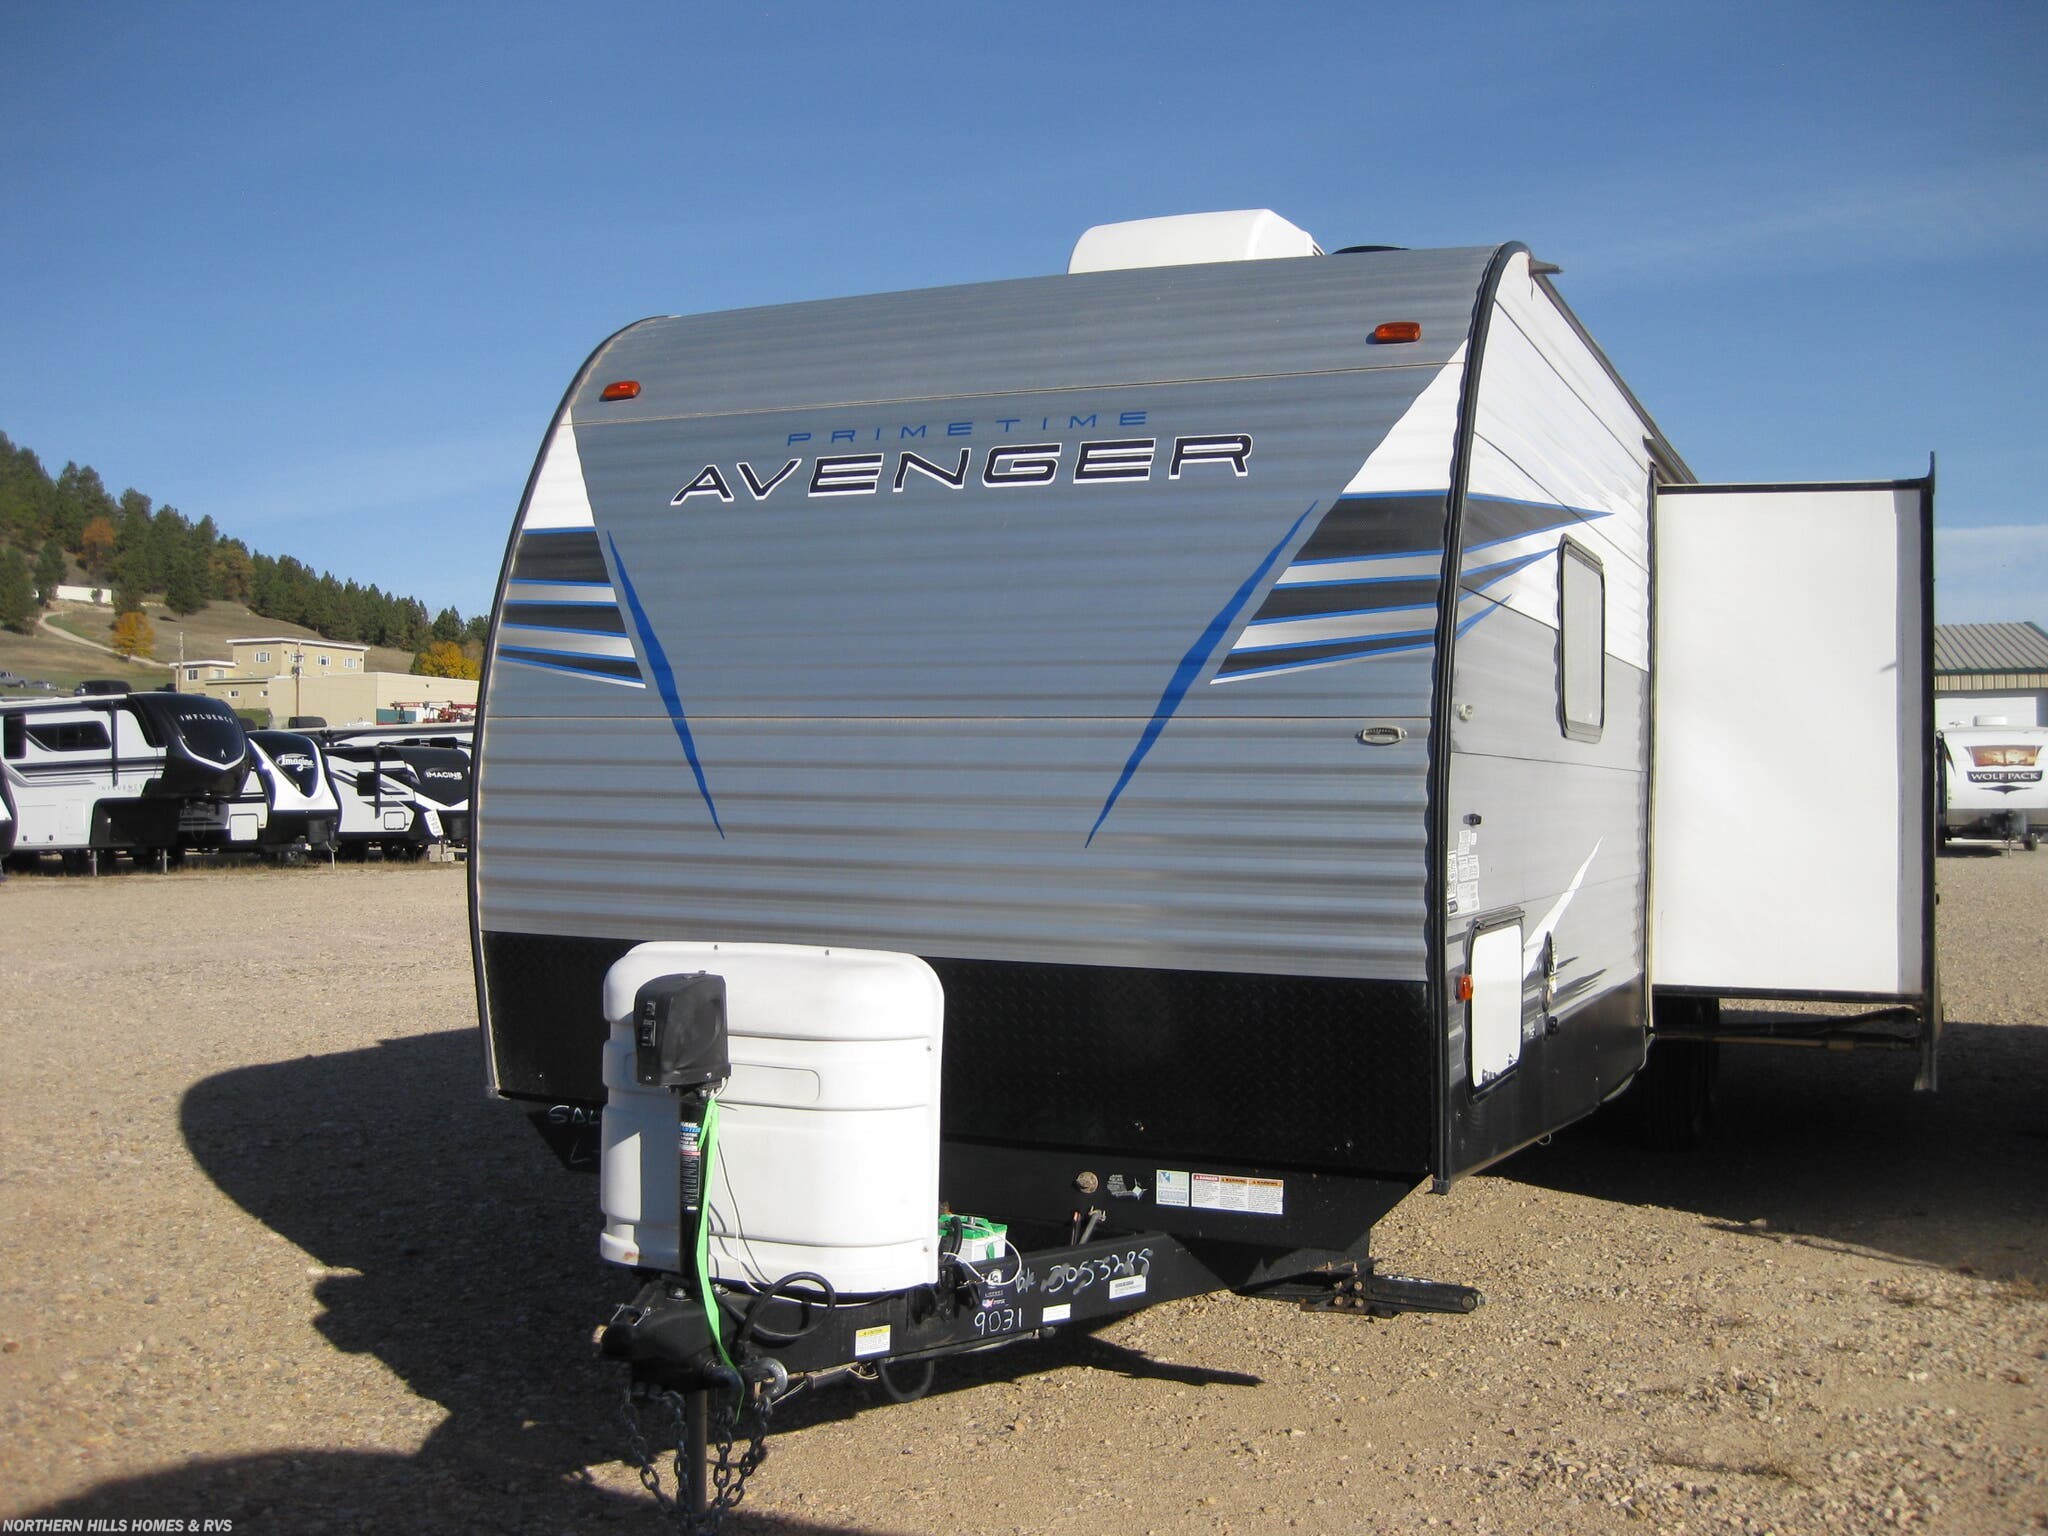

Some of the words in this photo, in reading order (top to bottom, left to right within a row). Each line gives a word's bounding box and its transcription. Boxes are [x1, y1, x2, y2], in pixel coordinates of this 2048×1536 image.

[670, 433, 1253, 506] AVENGER
[179, 713, 234, 724] INFLUENCE
[280, 755, 314, 771] Imagine
[1971, 772, 2005, 780] WOLF
[2008, 772, 2039, 780] PACK
[974, 1307, 1022, 1335] 9031
